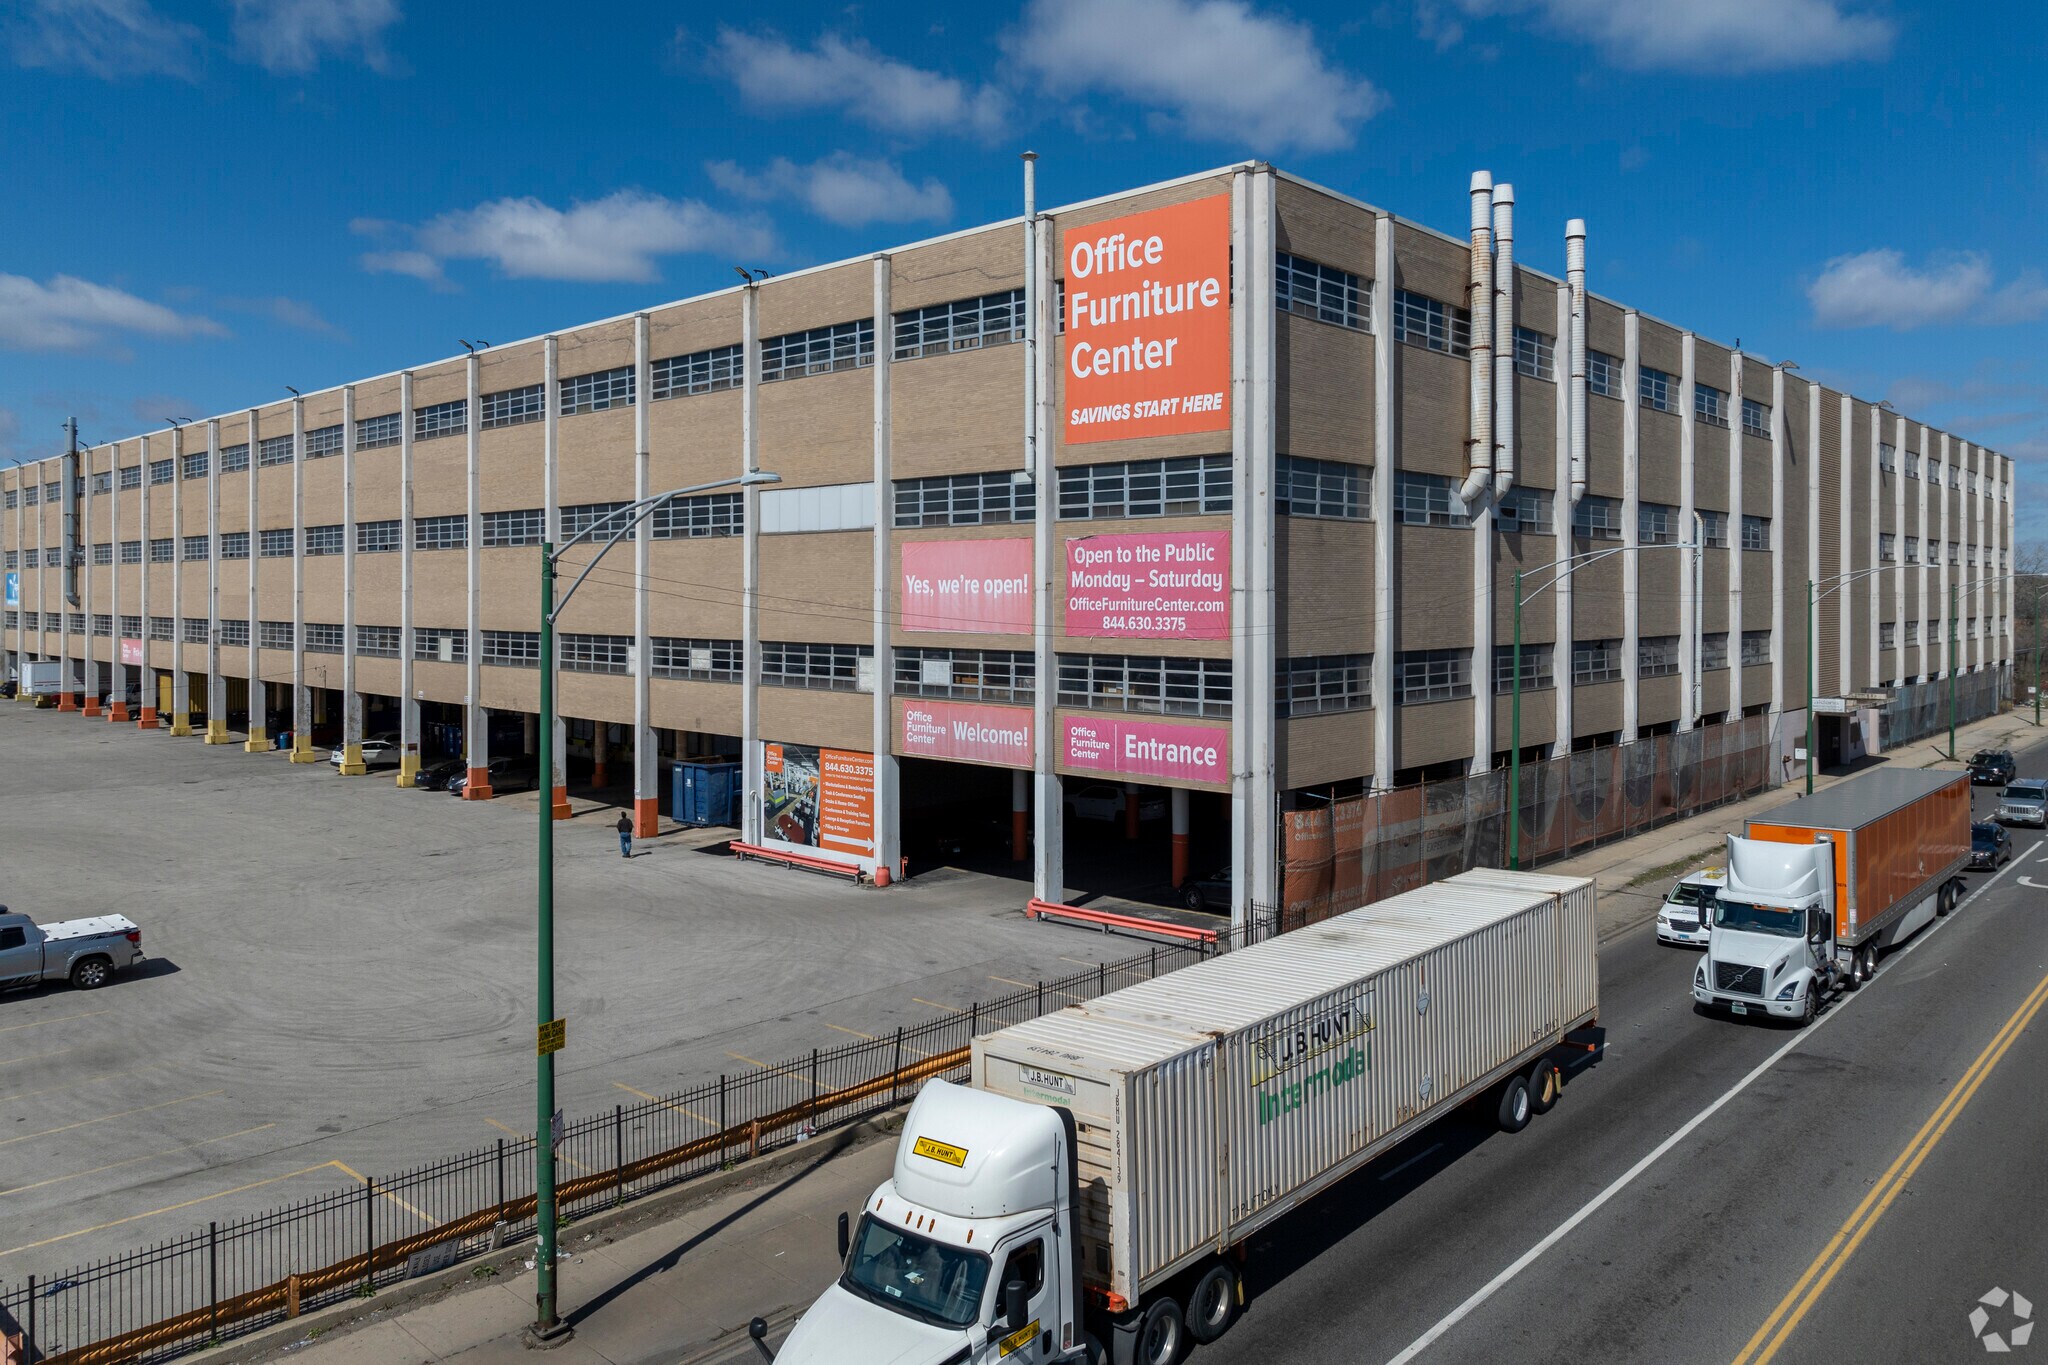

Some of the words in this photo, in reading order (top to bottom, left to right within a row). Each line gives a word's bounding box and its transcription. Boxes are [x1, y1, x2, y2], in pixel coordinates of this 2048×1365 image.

[1071, 233, 1163, 278] Office
[1072, 277, 1220, 329] Furniture
[1072, 335, 1177, 379] Center
[1071, 404, 1130, 425] SAVINGS
[1133, 397, 1179, 419] START
[1182, 393, 1223, 414] HERE
[1074, 546, 1112, 568] Open
[1117, 546, 1132, 562] to
[1135, 544, 1160, 562] the
[1165, 543, 1214, 562] Public
[906, 575, 934, 597] Yes,
[938, 575, 980, 594] we're
[982, 574, 1028, 598] open!
[1072, 570, 1130, 592] Monday
[1149, 569, 1222, 592] Saturday
[1070, 597, 1224, 612] OfficeFurnitureCenter.com
[1102, 615, 1186, 631] 844.630.3375
[906, 711, 932, 722] Office
[907, 722, 946, 734] Furniture
[953, 721, 1028, 747] Welcome!
[1071, 727, 1096, 738] Office
[907, 733, 936, 745] Center
[1071, 738, 1110, 750] Furniture
[1071, 748, 1099, 760] Center
[1125, 735, 1217, 766] Entrance
[825, 762, 874, 776] 844.630.3375
[1575, 822, 1604, 840] CUBICES
[551, 1020, 565, 1029] BUY
[1311, 1011, 1350, 1046] HUNT
[1044, 1073, 1064, 1088] HUNT
[1259, 1040, 1371, 1125] Intermodal
[1024, 1087, 1070, 1106] Intermodal
[937, 1148, 954, 1158] HUNT
